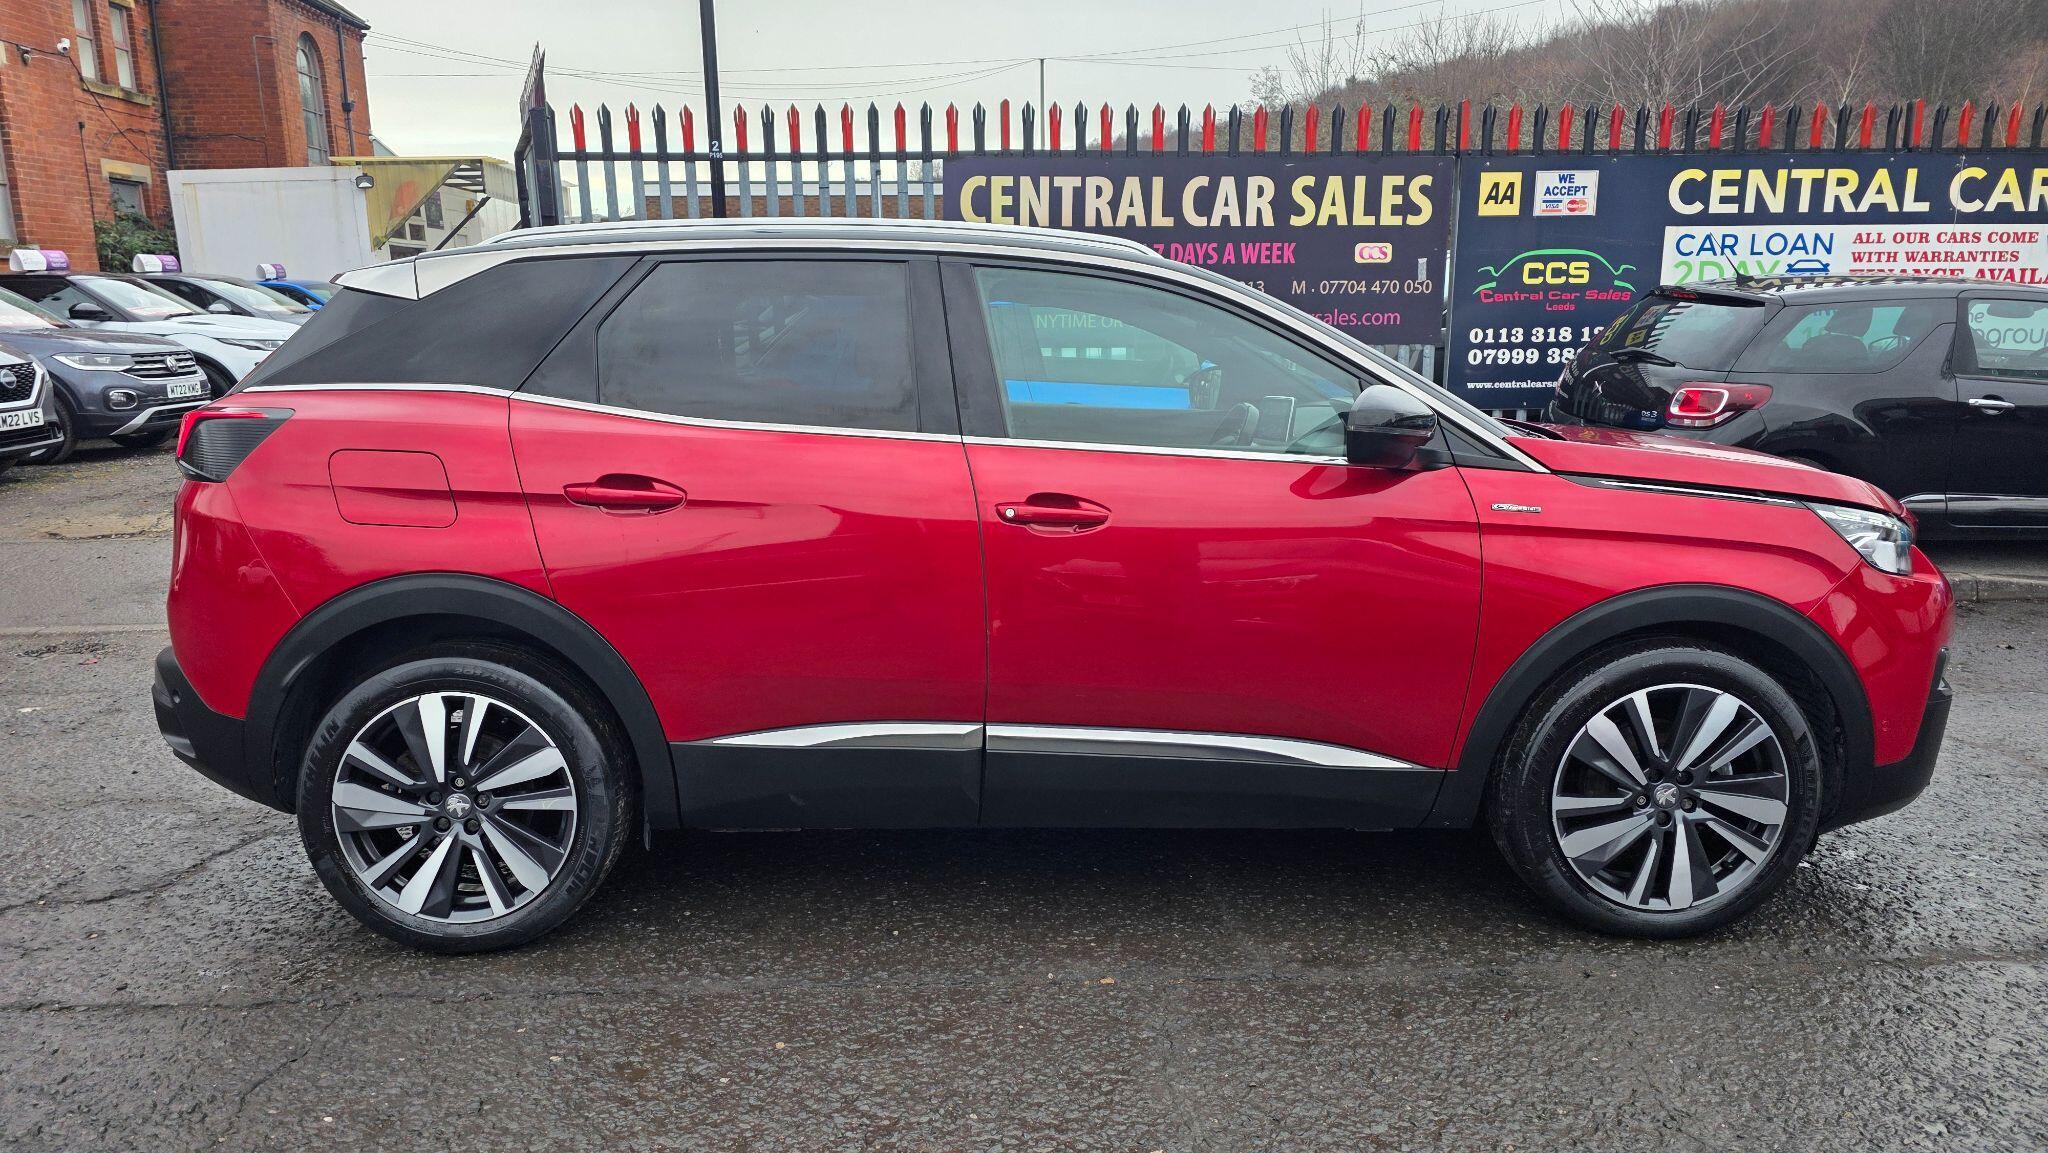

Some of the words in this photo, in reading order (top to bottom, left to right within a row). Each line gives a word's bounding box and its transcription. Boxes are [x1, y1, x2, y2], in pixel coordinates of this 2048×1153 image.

[711, 140, 720, 152] 2
[1558, 173, 1576, 184] WE
[1484, 181, 1516, 205] AA
[1543, 185, 1588, 197] ACCEPT
[1668, 168, 1931, 215] CENTRAL
[1949, 166, 2048, 213] CAR
[960, 175, 1175, 227] CENTRAL
[1182, 175, 1276, 227] CAR
[1289, 174, 1434, 227] SALES
[1675, 233, 1739, 257] CAR
[1749, 232, 1835, 256] LOAN
[1852, 231, 1886, 244] ALL
[1892, 231, 1931, 244] OUR
[1936, 231, 1982, 244] CARS
[1987, 231, 2040, 244] COME
[1170, 243, 1218, 265] DAYS
[1222, 243, 1236, 264] A
[1241, 243, 1297, 264] WEEK
[1851, 251, 1899, 263] WITH
[1904, 250, 2020, 263] WARRANTIES
[1522, 261, 1591, 285] CCS
[1319, 280, 1366, 294] 07704
[1371, 280, 1399, 294] 470
[1404, 279, 1433, 294] 050
[1480, 289, 1544, 304] Central
[1548, 290, 1581, 300] Car
[1584, 289, 1632, 301] Sales
[1545, 302, 1576, 311] Leeds
[1469, 327, 1524, 344] 0113
[1531, 326, 1573, 343] 318
[1467, 348, 1540, 366] 07999
[0, 413, 20, 428] M22
[22, 411, 40, 425] LVS
